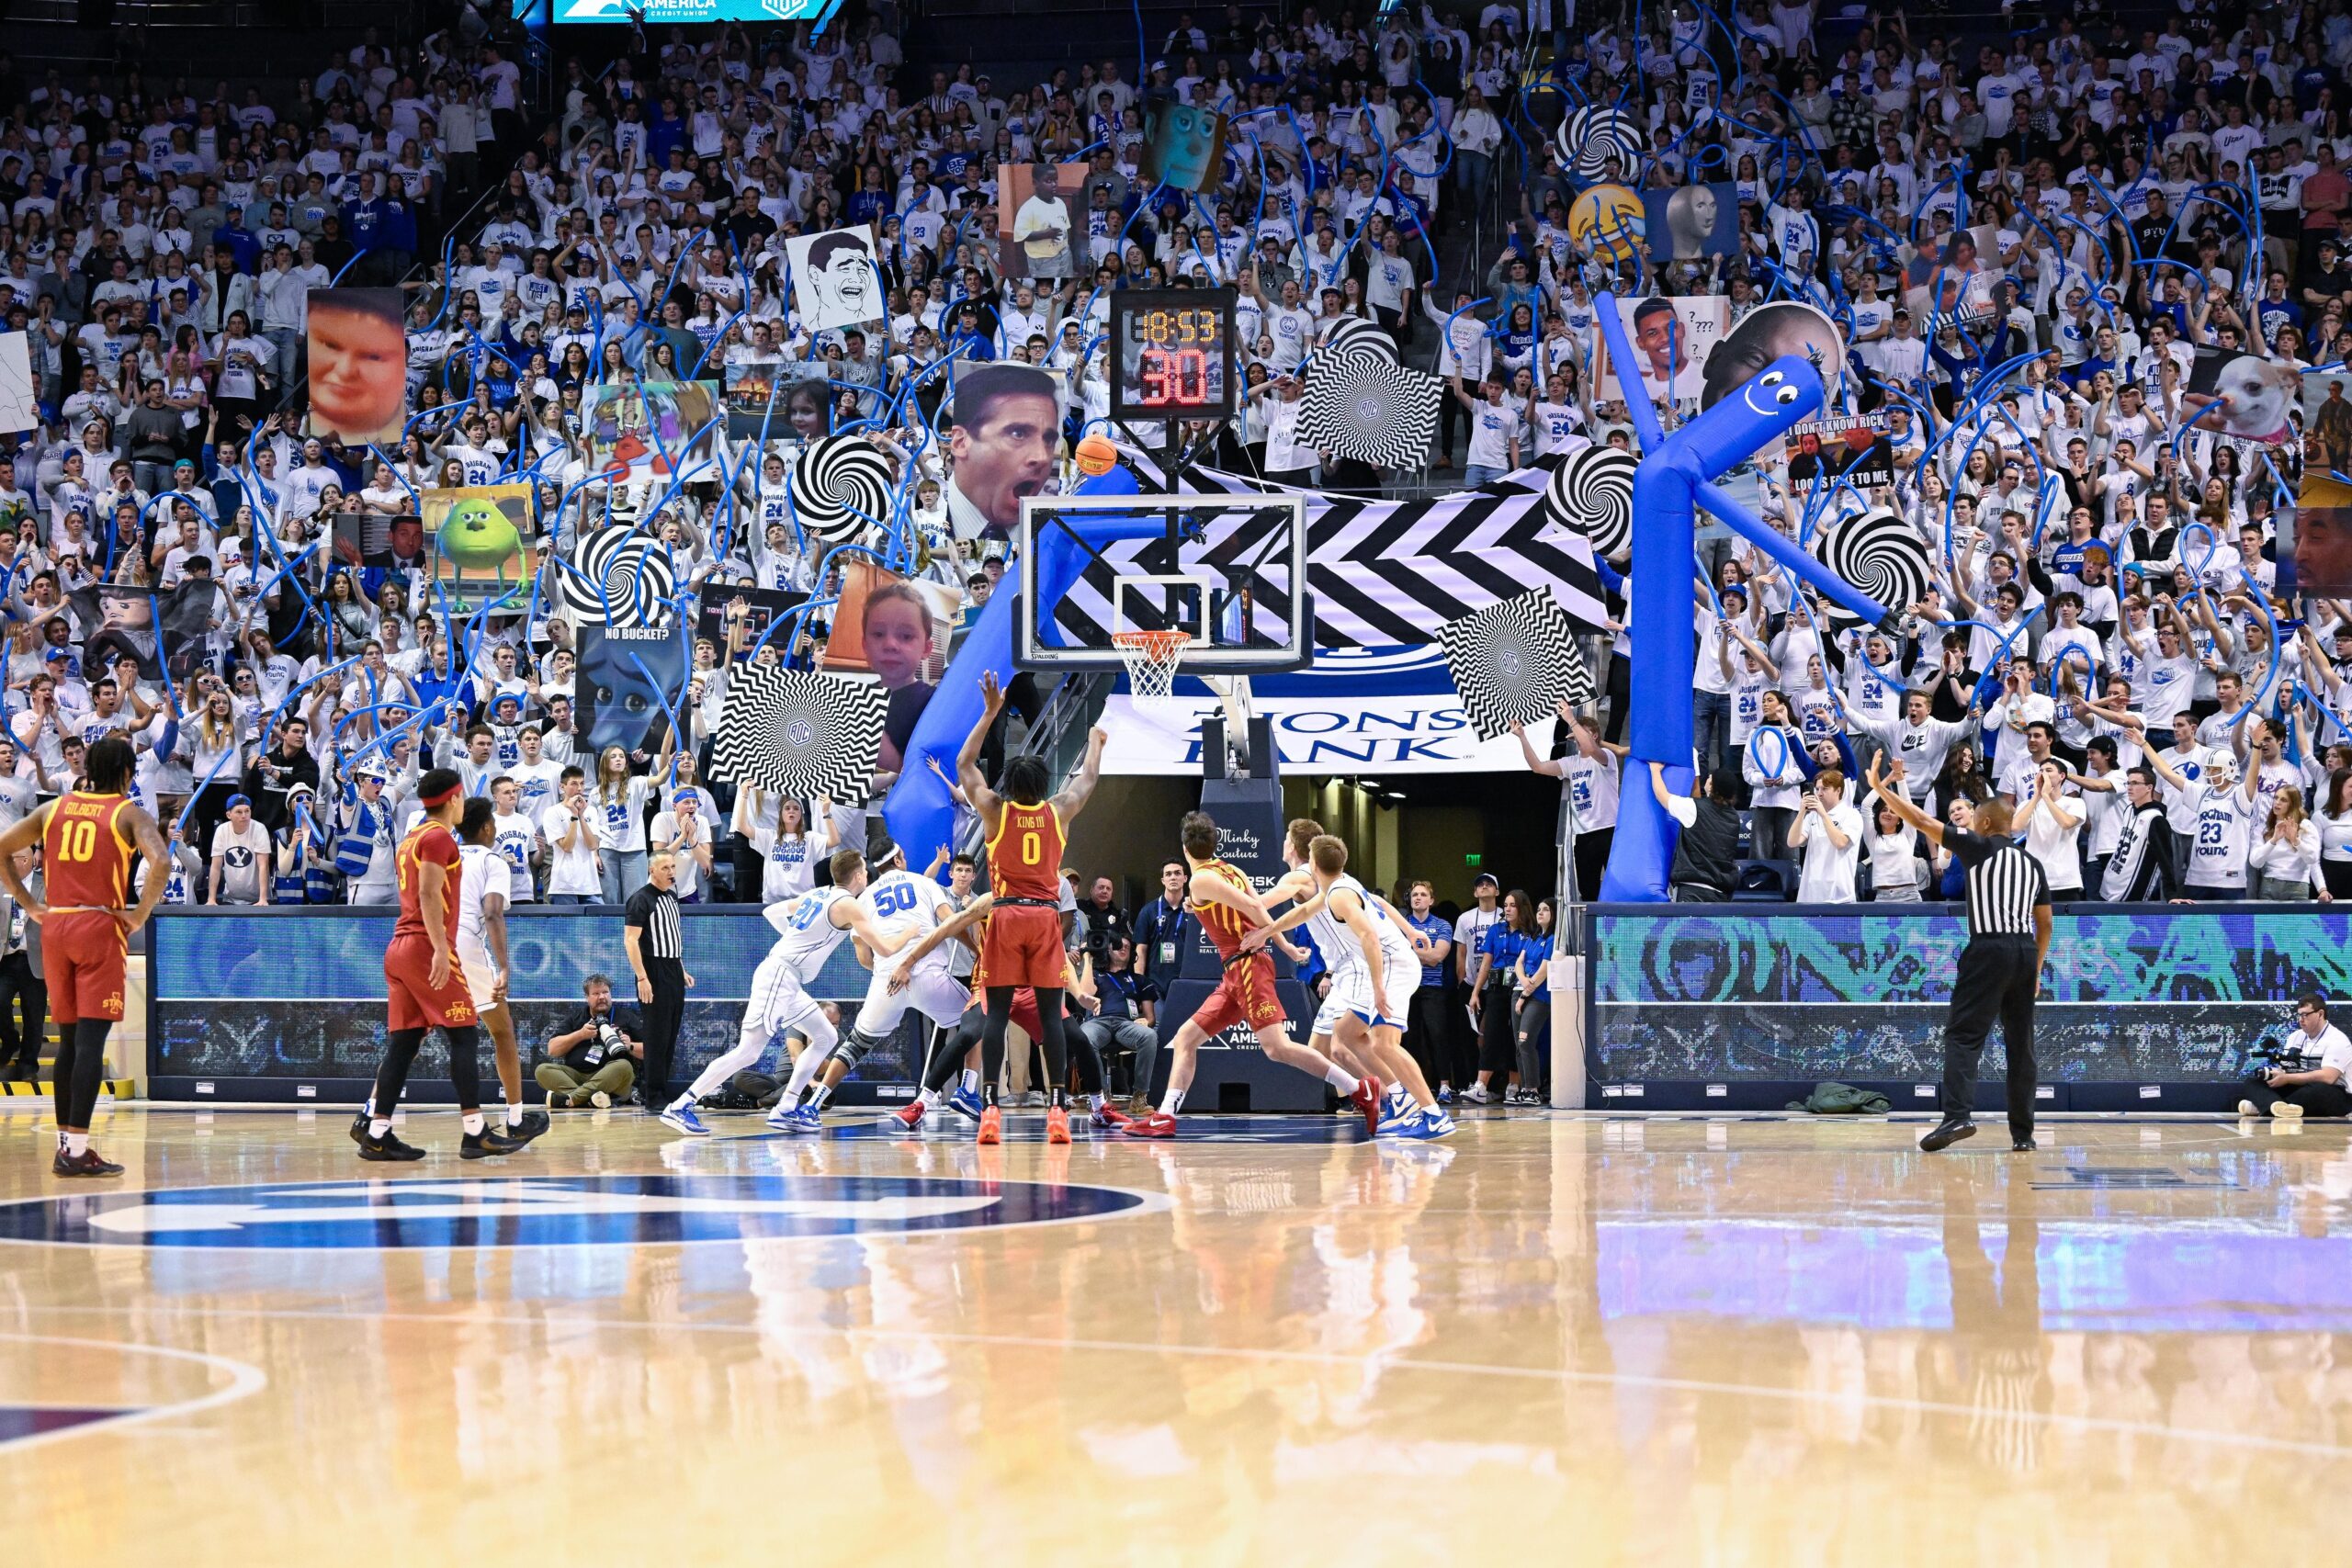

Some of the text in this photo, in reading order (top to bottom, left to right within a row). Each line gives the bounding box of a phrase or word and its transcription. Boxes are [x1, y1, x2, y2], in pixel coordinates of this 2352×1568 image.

[1692, 85, 1707, 97] 24
[154, 144, 169, 157] 24
[948, 158, 965, 168] BE
[496, 231, 522, 242] BRIGHAM
[913, 226, 926, 238] 23
[1091, 225, 1106, 235] 24
[1259, 228, 1283, 237] BRIGHAM
[1787, 229, 1799, 243] 24
[2143, 227, 2165, 238] BYU
[530, 282, 548, 293] JUST
[1689, 311, 1696, 322] ?
[1143, 310, 1216, 343] 18:53
[1695, 321, 1714, 333] ???
[1549, 348, 1559, 364] Y
[1691, 344, 1699, 355] ?
[1143, 347, 1206, 405] 30
[1359, 401, 1378, 418] ROC
[1547, 412, 1575, 421] BRIGHAM
[1552, 422, 1569, 435] 24
[1787, 412, 1884, 436] I DON'T KNOW RICK
[466, 460, 492, 472] BRIGHAM
[469, 470, 487, 485] 24
[1794, 470, 1888, 492] LOOS FE TO ME
[765, 502, 783, 517] 24
[920, 524, 944, 535] RIGHAM
[2056, 553, 2084, 564] COUGARS
[605, 627, 670, 641] NO BUCKET?
[1030, 652, 1059, 661] SPALDING
[1862, 682, 1883, 699] 24
[1738, 696, 1757, 714] 24
[1802, 703, 1834, 715] BRIGHAM
[1861, 701, 1883, 709] YOUNG
[1738, 714, 1758, 724] YOUNG
[85, 725, 108, 738] MAKE
[790, 723, 810, 742] ROC
[1904, 734, 1926, 746] NIKE
[499, 744, 518, 760] 24
[1572, 781, 1589, 799] 24
[64, 803, 105, 818] GILBERT
[605, 803, 629, 823] 24
[608, 823, 630, 832] YOUNG
[1017, 816, 1045, 829] KING III
[495, 832, 528, 845] BRIGHAM
[1216, 827, 1261, 848] Minky
[2199, 824, 2222, 843] 23
[57, 820, 96, 862] 10
[1023, 832, 1041, 865] 0
[1213, 843, 1259, 859] Couture
[772, 853, 806, 863] COUGARS
[1465, 853, 1482, 866] EXIT
[509, 865, 525, 874] OUNG
[877, 874, 907, 887] KHALIFA
[873, 882, 919, 918] 50
[788, 897, 823, 931] 20
[445, 1007, 472, 1017] STATE
[1256, 1005, 1278, 1019] STATE
[1227, 1020, 1297, 1032] MOUIN
